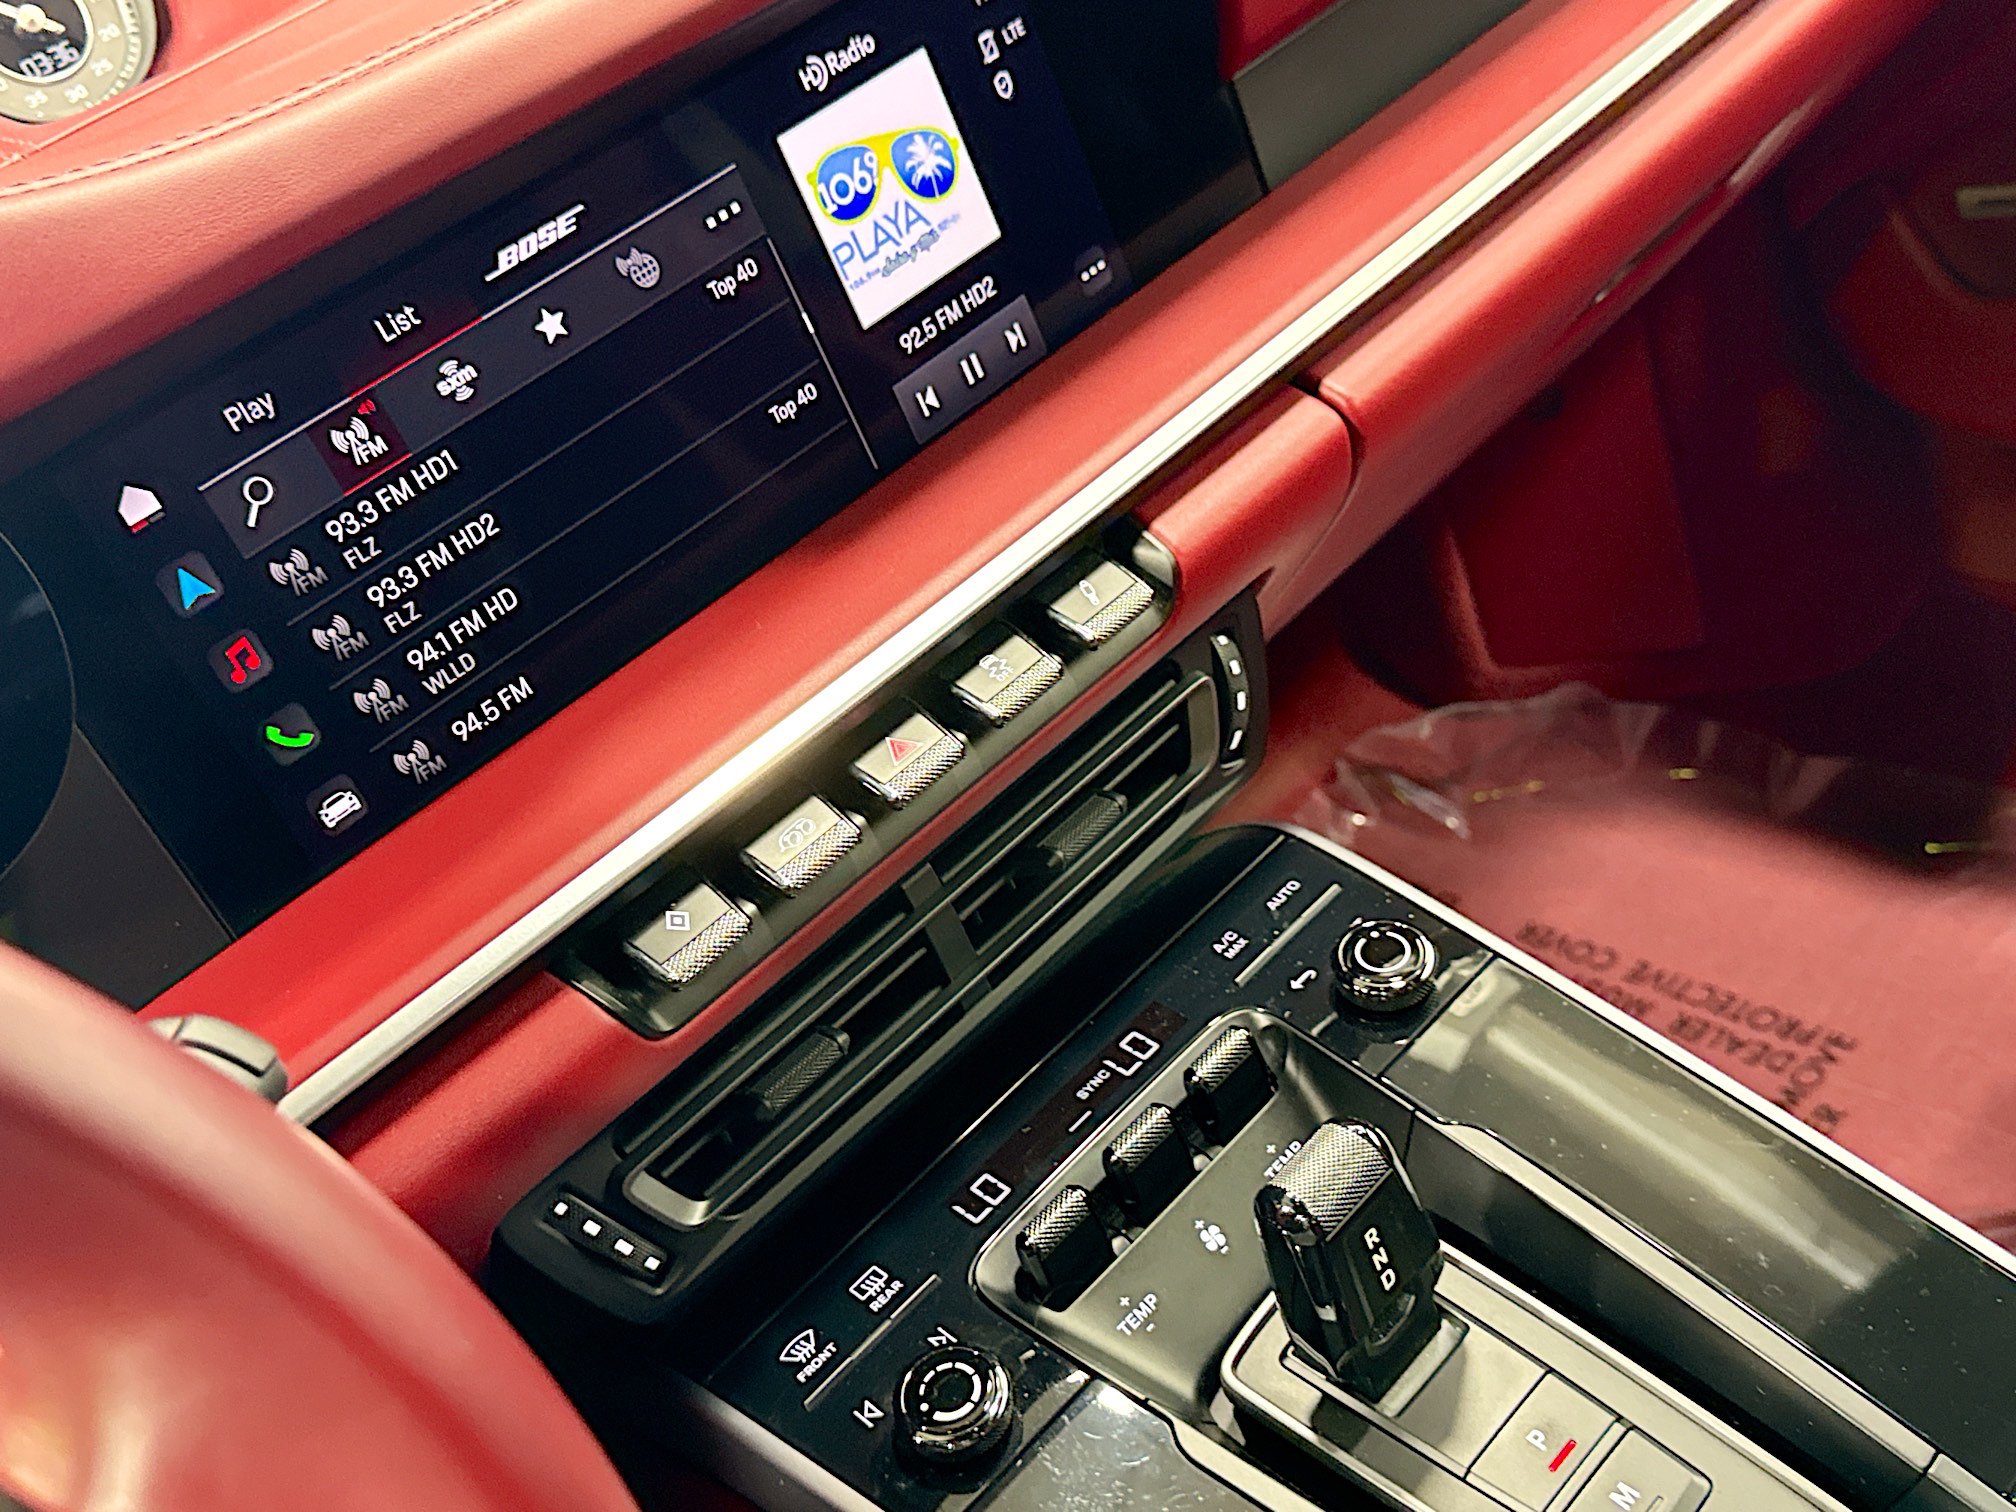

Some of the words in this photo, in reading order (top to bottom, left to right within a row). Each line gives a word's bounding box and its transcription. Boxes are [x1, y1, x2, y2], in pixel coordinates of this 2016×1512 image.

[1001, 16, 1027, 45] LTE
[825, 34, 876, 76] Radio
[485, 204, 585, 281] BOSE
[832, 201, 931, 280] PLAYA
[706, 275, 737, 299] Top
[737, 258, 758, 282] 40
[373, 304, 421, 343] List
[899, 316, 937, 354] 92.5
[934, 299, 964, 331] FM
[960, 275, 998, 313] HD2
[436, 364, 479, 397] sxm
[222, 392, 275, 433] Play
[768, 400, 798, 423] Top
[797, 383, 818, 405] 40
[357, 435, 389, 465] FM
[325, 500, 379, 543] 93.3
[375, 476, 417, 513] FM
[410, 449, 459, 490] HD1
[342, 536, 382, 570] FLZ
[366, 566, 419, 608] 93.3
[414, 542, 455, 578] FM
[449, 513, 501, 555] HD2
[297, 565, 330, 594] FM
[383, 601, 422, 634] FLZ
[406, 631, 453, 671] 94.1
[448, 609, 487, 644] FM
[482, 587, 518, 622] HD
[341, 631, 370, 659] FM
[421, 652, 476, 695] WLLD
[379, 694, 409, 722] FM
[451, 698, 500, 741] 94.5
[497, 676, 534, 711] FM
[418, 754, 448, 782] FM
[1266, 880, 1301, 911] AUTO
[1213, 931, 1239, 954] A/C
[1223, 937, 1249, 959] MAX
[1076, 1068, 1111, 1100] SYNC
[1263, 1140, 1302, 1179] TEMP
[869, 1280, 904, 1312] REAR
[1116, 1293, 1158, 1336] TEMP
[796, 1342, 837, 1383] FRONT
[1525, 1429, 1547, 1451] P
[1608, 1481, 1641, 1511] M
